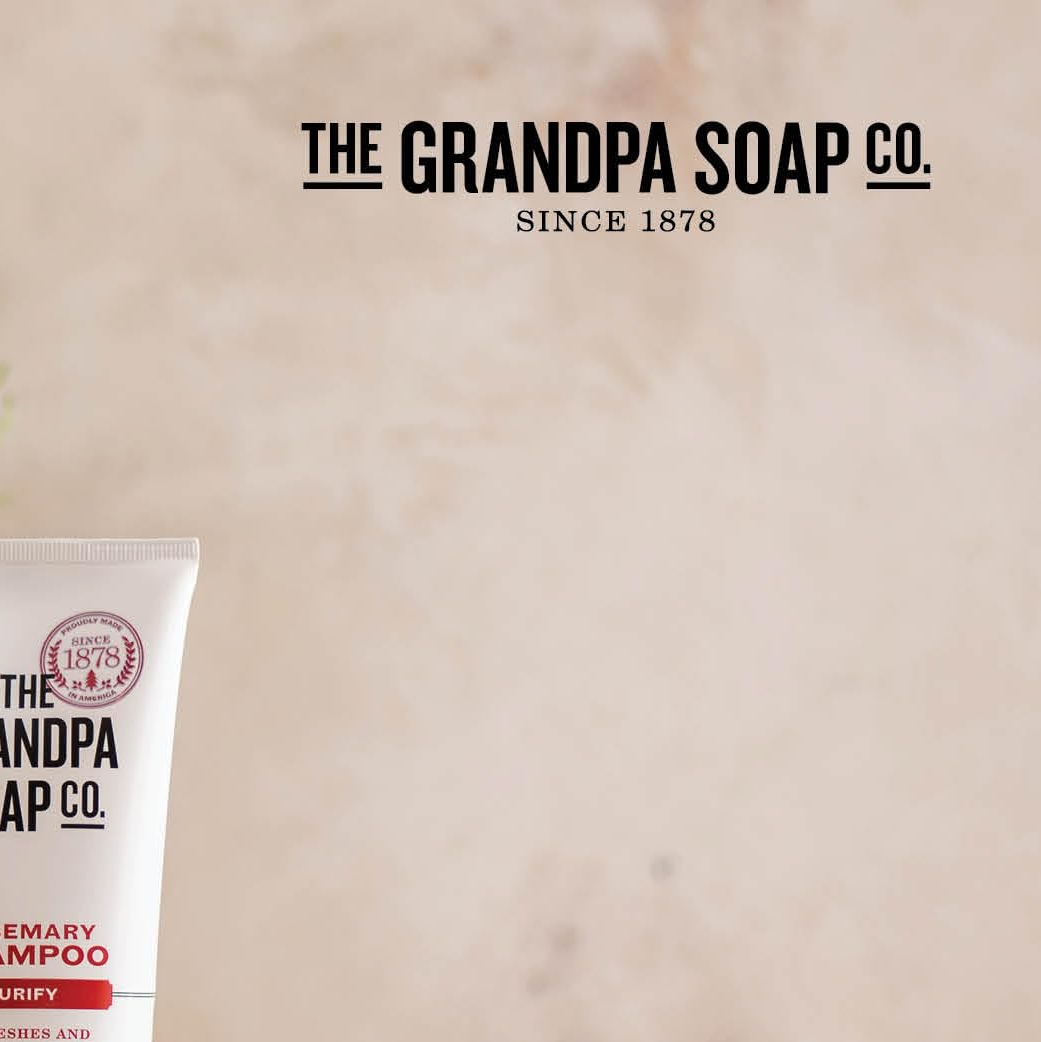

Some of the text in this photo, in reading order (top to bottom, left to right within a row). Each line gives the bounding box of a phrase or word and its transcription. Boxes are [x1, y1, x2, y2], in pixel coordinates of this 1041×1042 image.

[61, 617, 124, 636] PROUDLY MADE
[71, 635, 111, 646] SINCE
[63, 646, 121, 670] 1878
[0, 674, 55, 708] THE
[78, 689, 117, 702] AMERICA
[60, 780, 105, 818] CO.
[55, 1028, 90, 1040] AND
